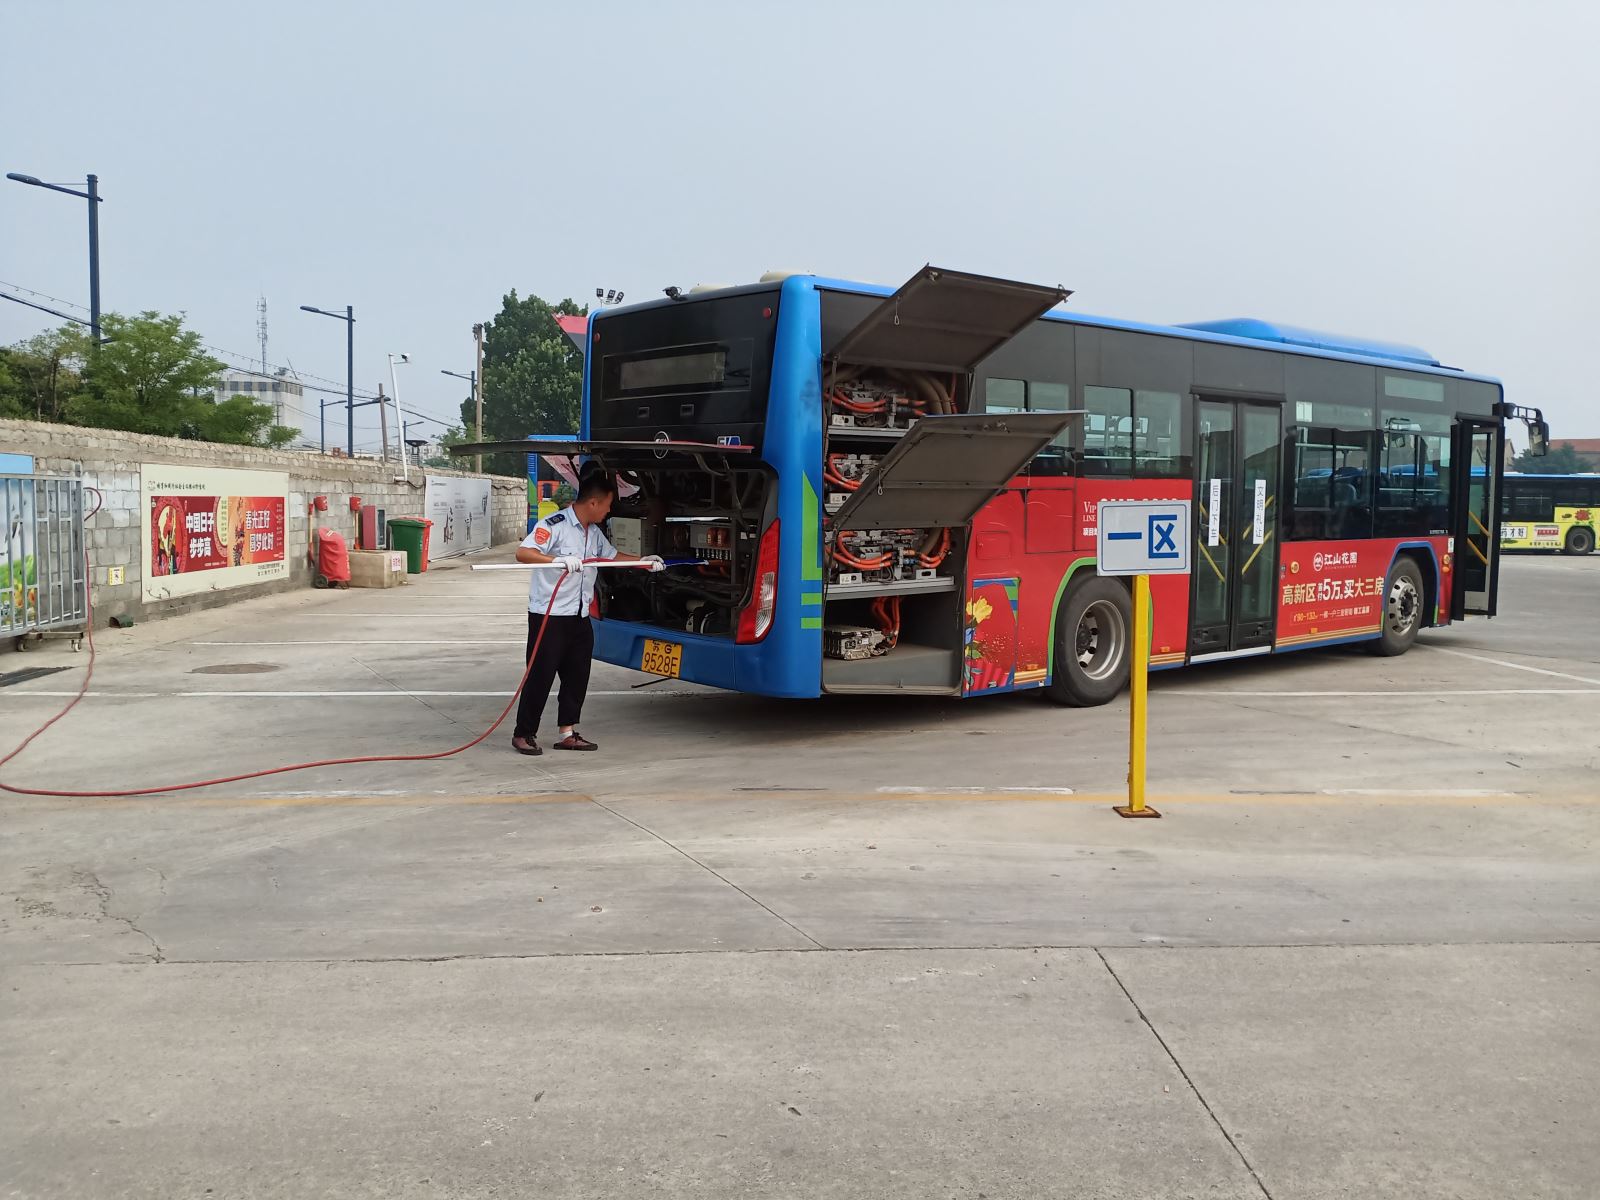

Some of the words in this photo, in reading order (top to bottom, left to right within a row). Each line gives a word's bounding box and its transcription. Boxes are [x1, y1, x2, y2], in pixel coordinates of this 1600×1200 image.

[185, 511, 214, 533] 中国日子
[245, 510, 270, 529] 春光正好
[1083, 514, 1096, 522] LINE
[1210, 484, 1220, 538] 后门下车
[1255, 485, 1265, 538] 文明礼让
[189, 536, 211, 558] 步步高
[249, 532, 274, 552] 圆梦此时
[1107, 514, 1179, 559] 一区
[1324, 552, 1358, 566] 江山花园
[644, 651, 679, 675] 9528E
